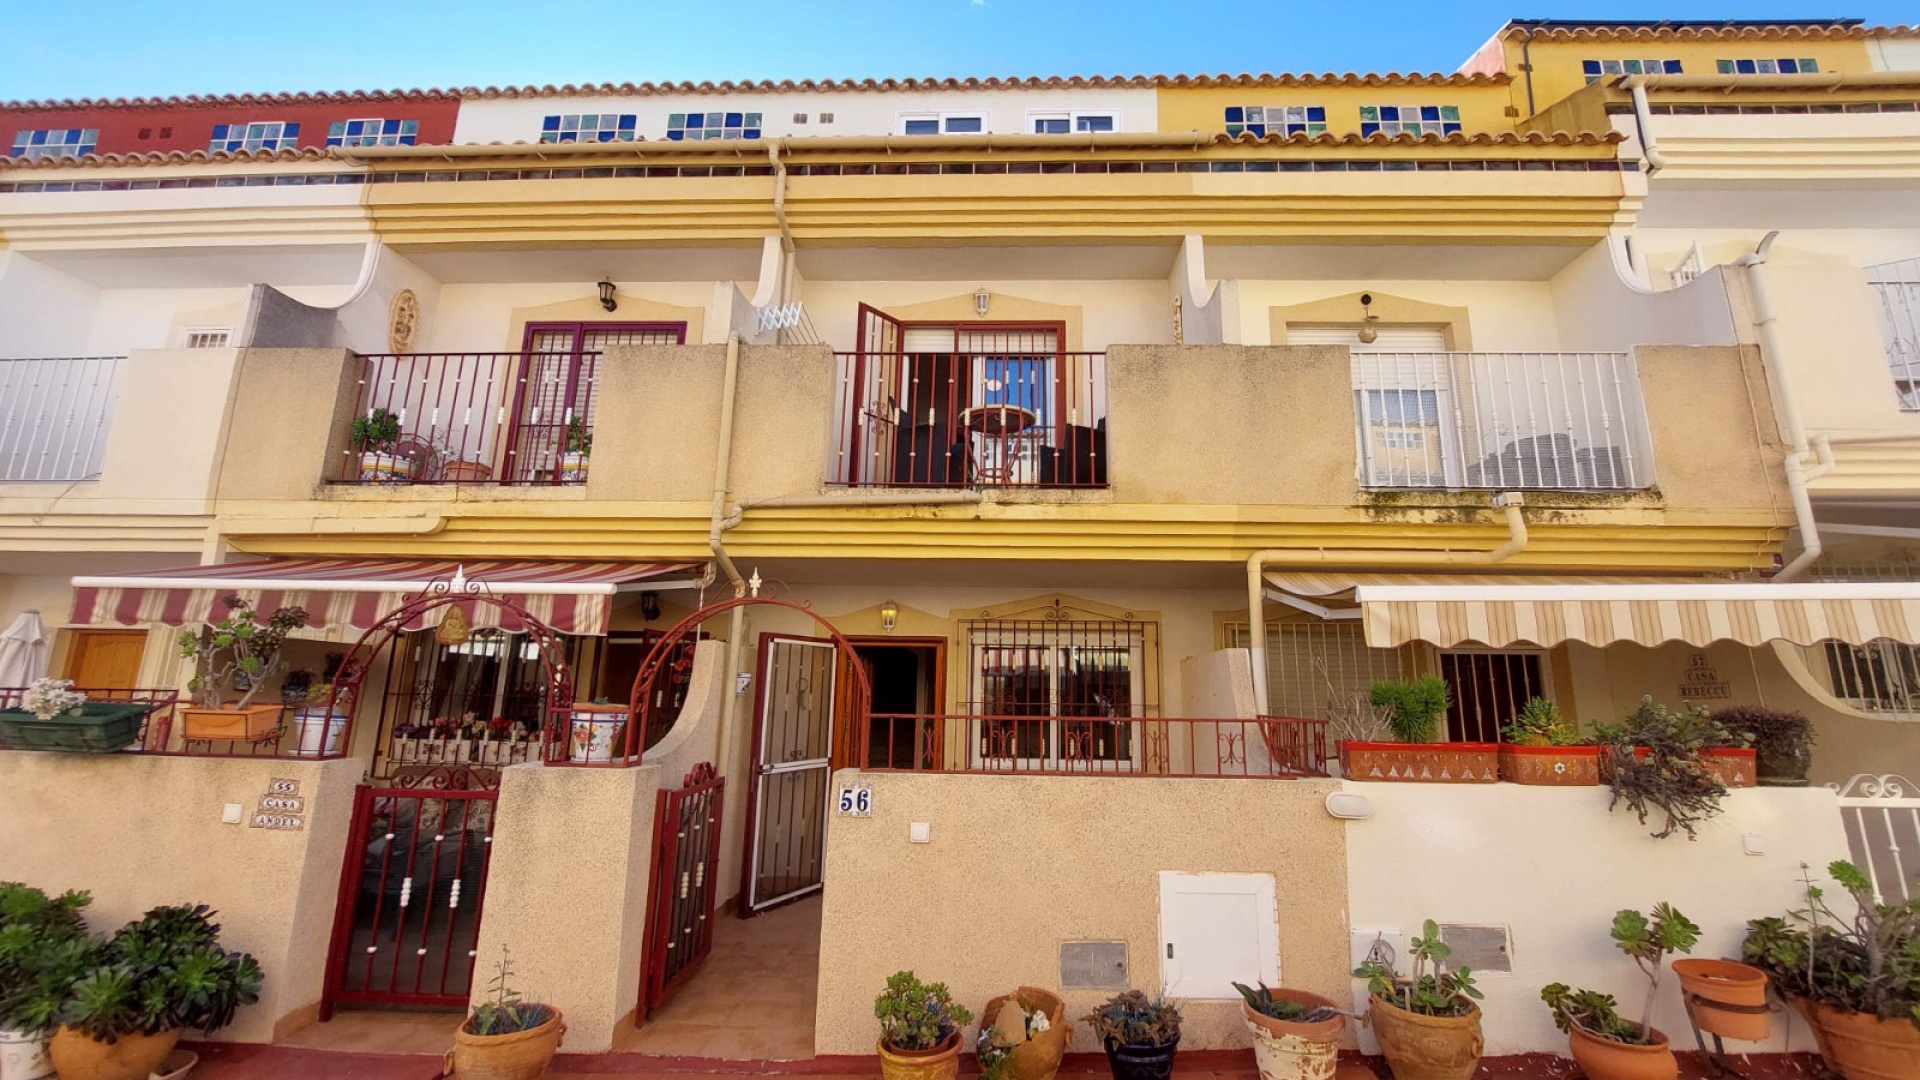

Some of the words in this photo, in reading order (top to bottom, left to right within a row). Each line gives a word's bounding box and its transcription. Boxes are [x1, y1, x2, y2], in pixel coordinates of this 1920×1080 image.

[1692, 656, 1705, 667] 57
[1687, 671, 1716, 681] CASA
[266, 798, 296, 810] CASA
[840, 789, 869, 812] 56
